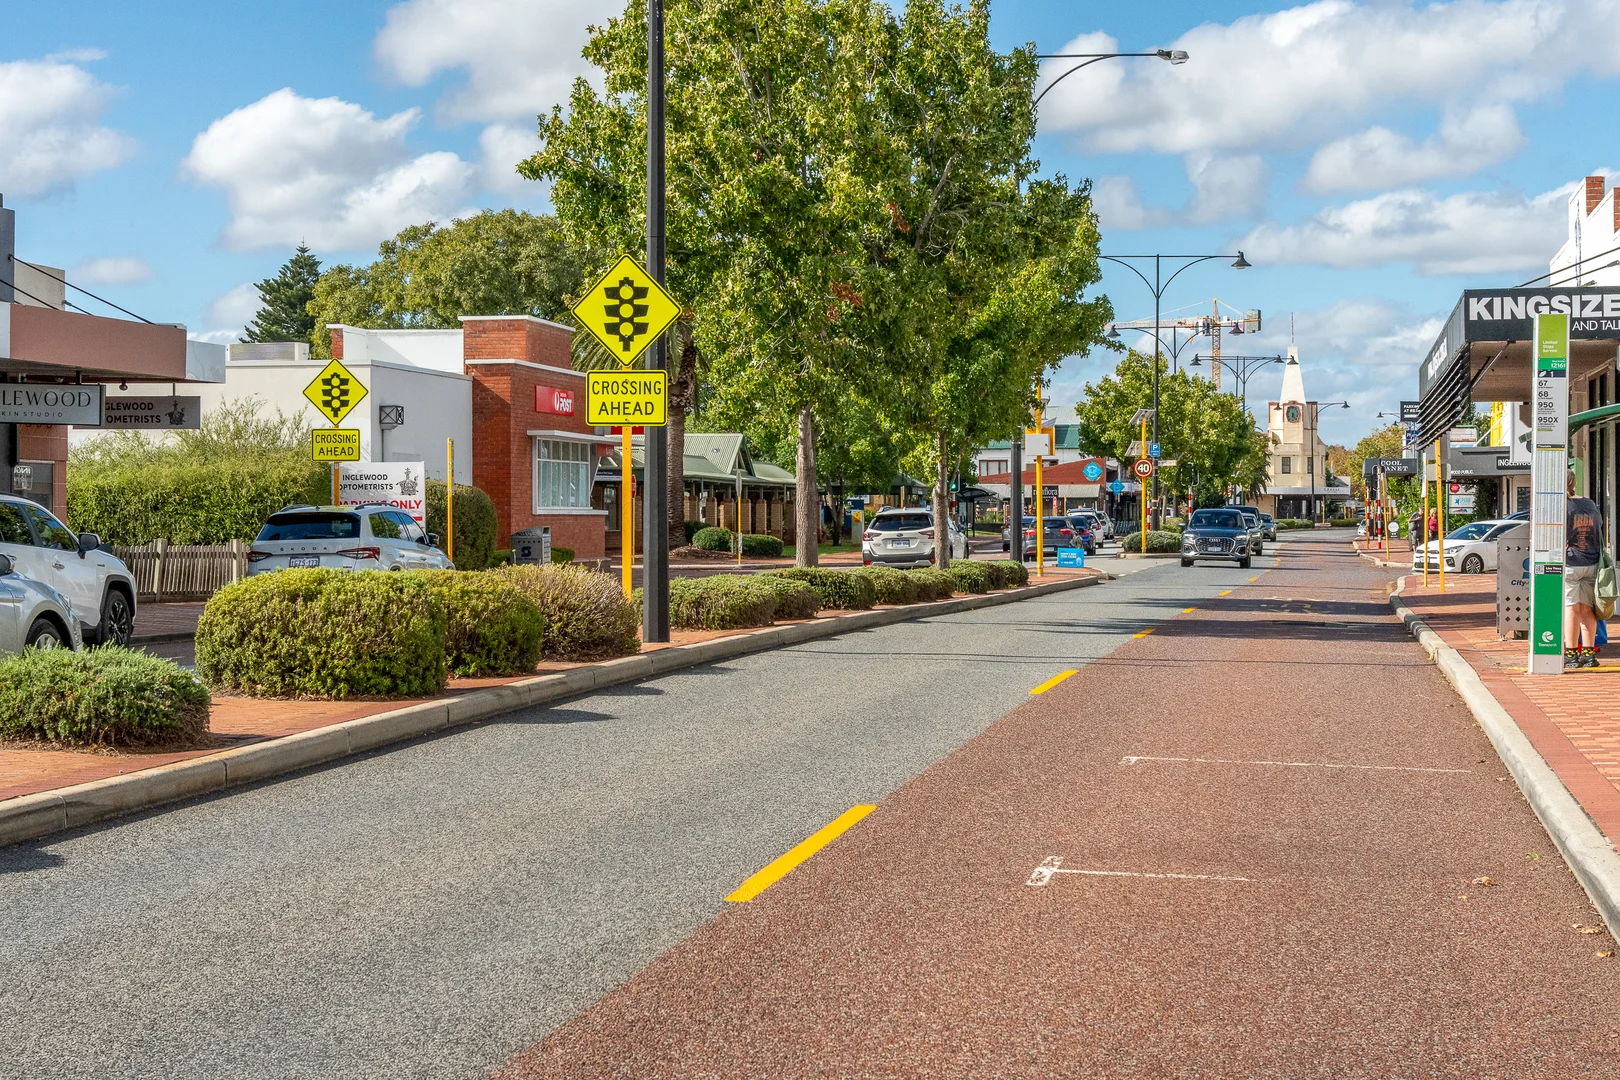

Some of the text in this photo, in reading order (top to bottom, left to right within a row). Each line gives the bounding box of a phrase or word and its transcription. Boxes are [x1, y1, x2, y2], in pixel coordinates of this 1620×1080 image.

[1469, 294, 1620, 320] KINGSIZE
[1572, 320, 1598, 331] AND
[592, 380, 661, 395] CROSSING
[2, 390, 91, 407] LEWOOD
[105, 402, 154, 411] GLEWOOD
[560, 397, 572, 412] POST
[598, 401, 655, 415] AHEAD
[106, 415, 161, 423] OMETRISTS
[315, 434, 357, 444] CROSSING
[318, 447, 354, 456] AHEAD
[1137, 464, 1149, 473] 40
[392, 500, 423, 509] ONLY
